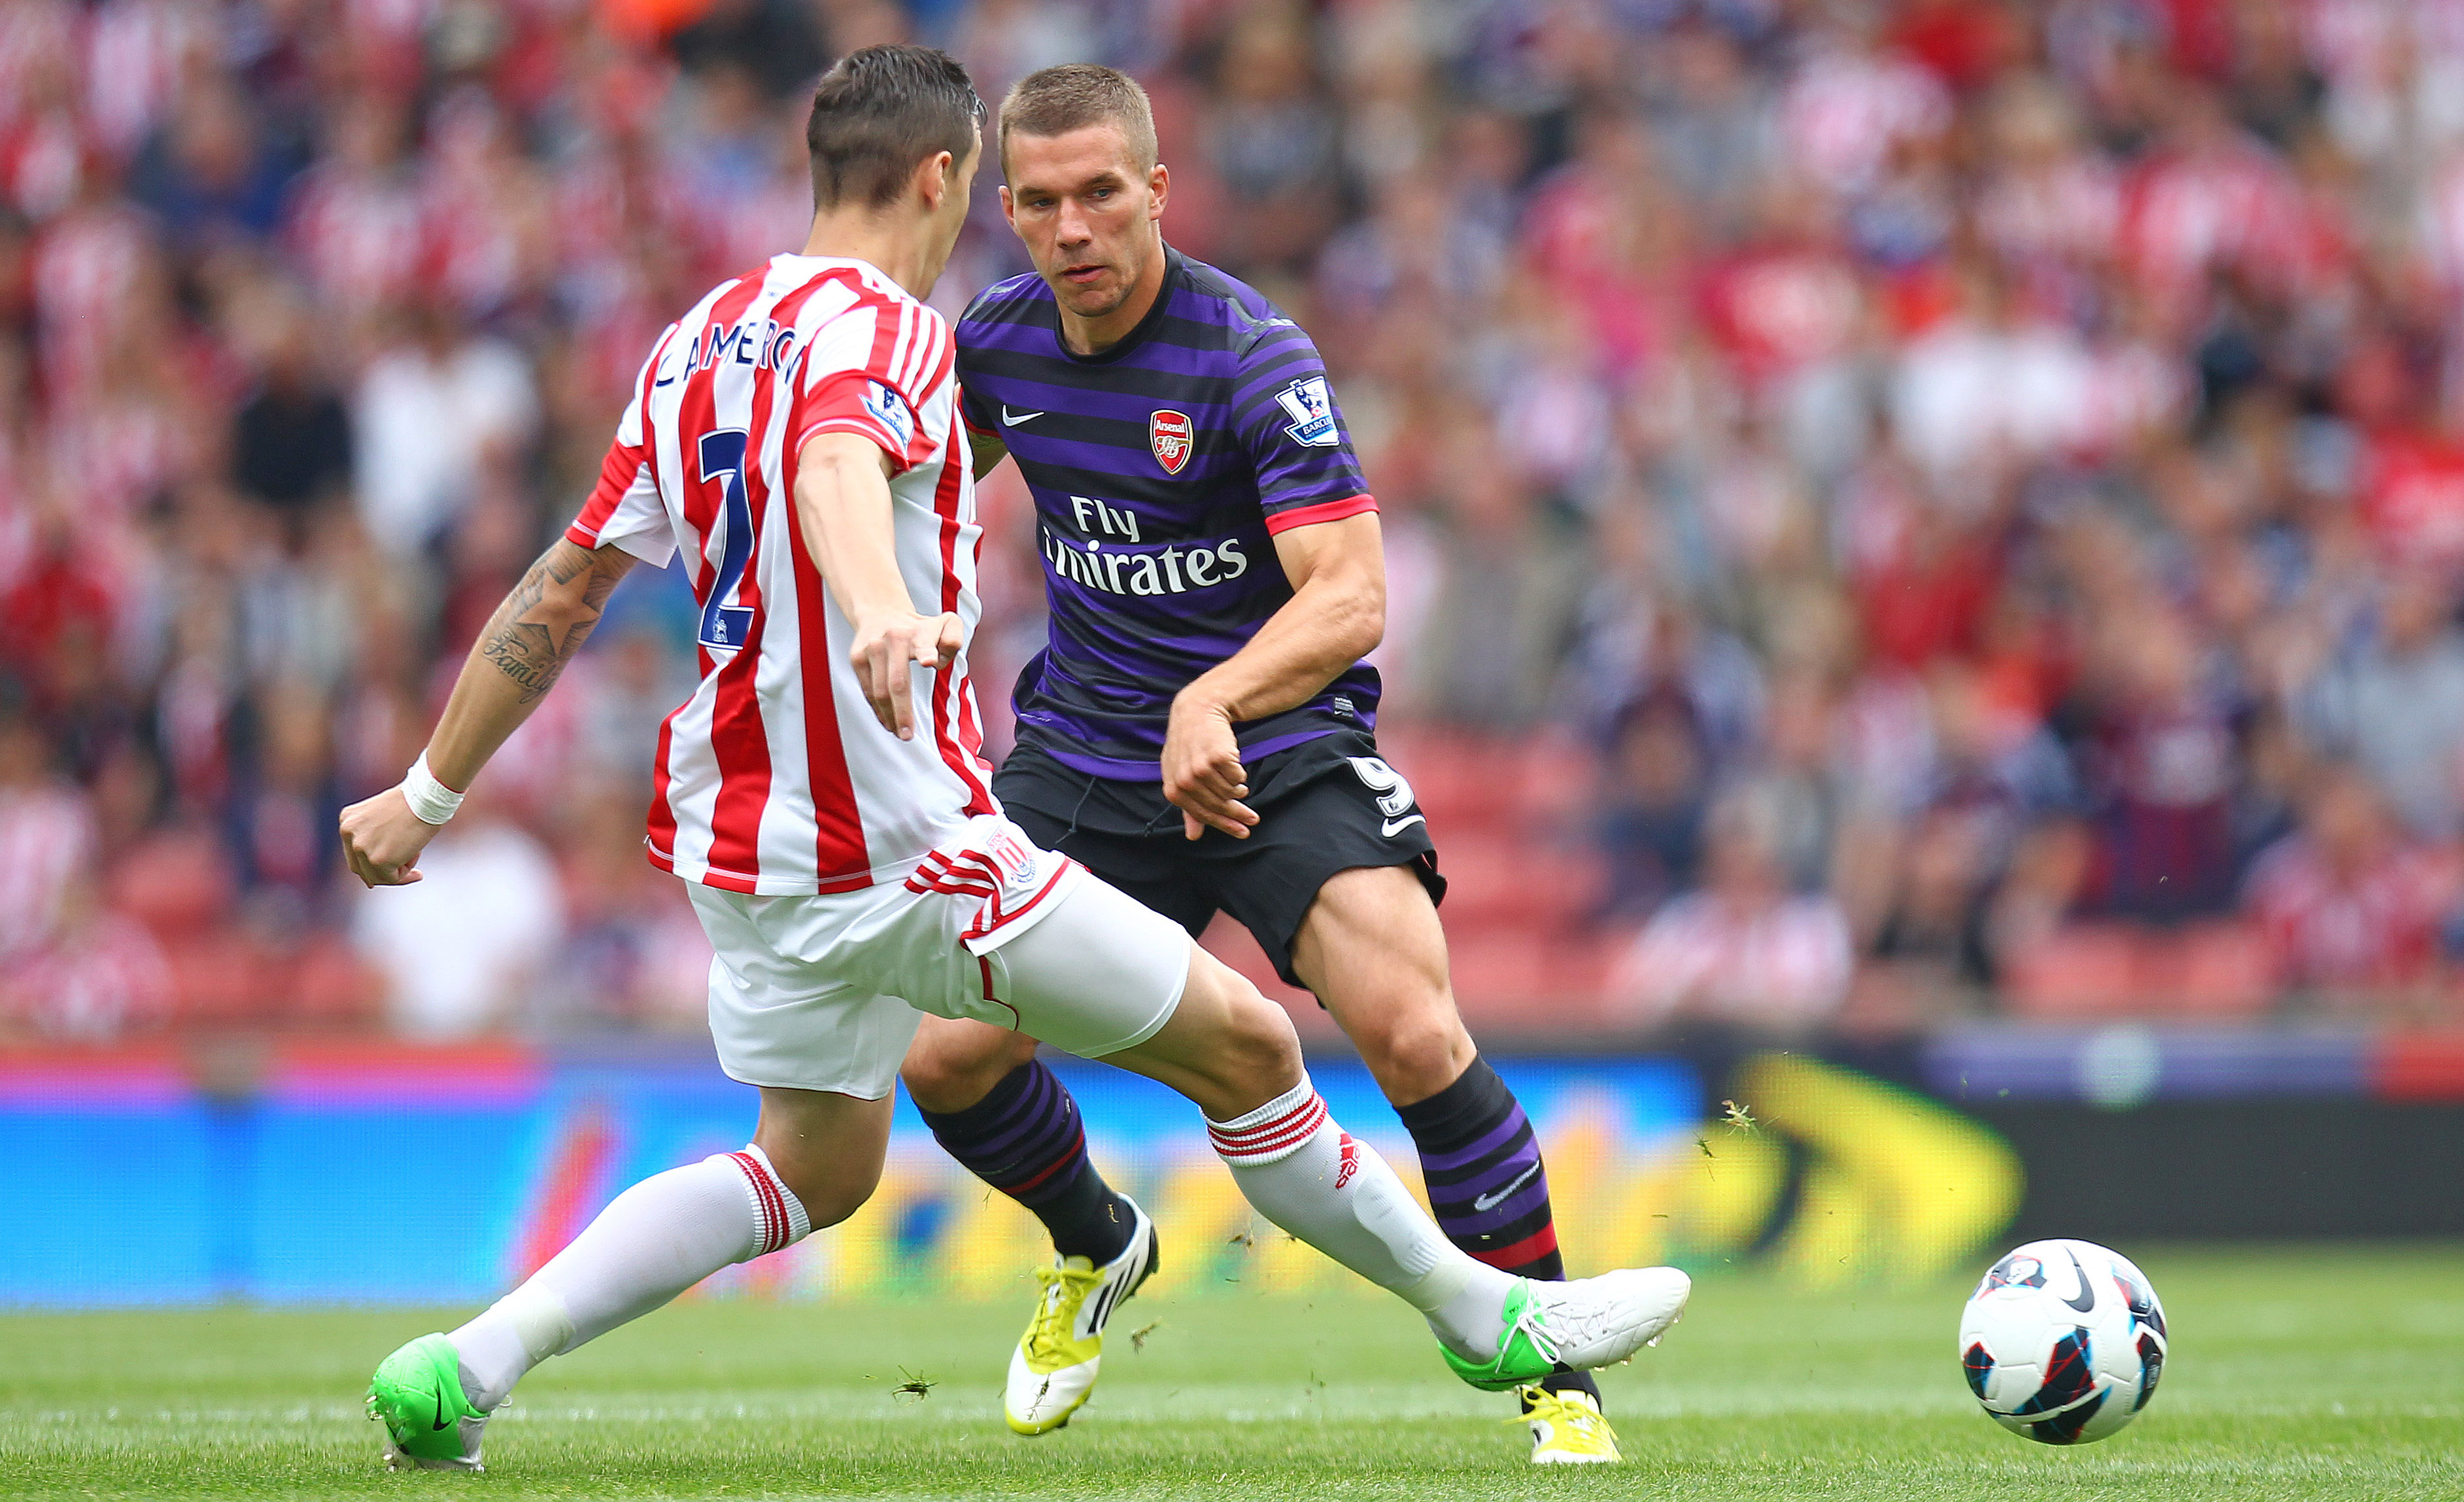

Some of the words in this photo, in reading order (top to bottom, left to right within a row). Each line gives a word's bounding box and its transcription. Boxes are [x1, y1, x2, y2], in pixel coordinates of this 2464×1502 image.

[1155, 419, 1186, 433] Arsenal
[1303, 416, 1332, 435] BARCL
[697, 427, 755, 650] 2
[1070, 495, 1140, 542] Fly
[483, 630, 557, 704] Family
[1346, 757, 1415, 817] 9
